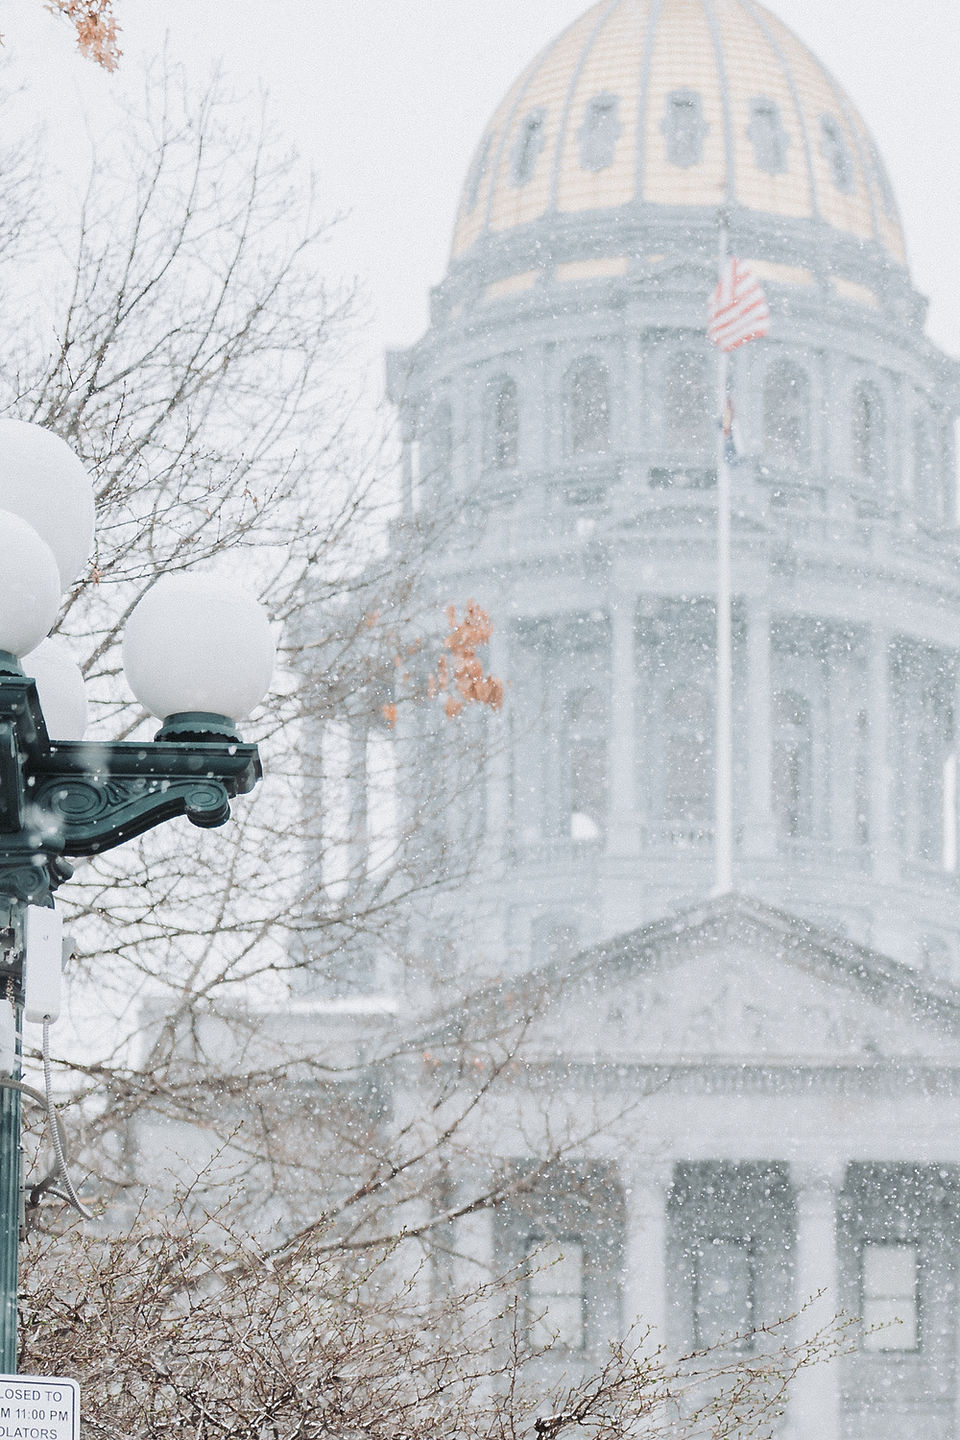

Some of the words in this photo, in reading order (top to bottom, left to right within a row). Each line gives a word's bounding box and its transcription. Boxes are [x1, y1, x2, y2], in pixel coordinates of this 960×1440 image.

[45, 1391, 62, 1402] TO
[16, 1408, 46, 1420] 11:00
[50, 1410, 68, 1421] PM
